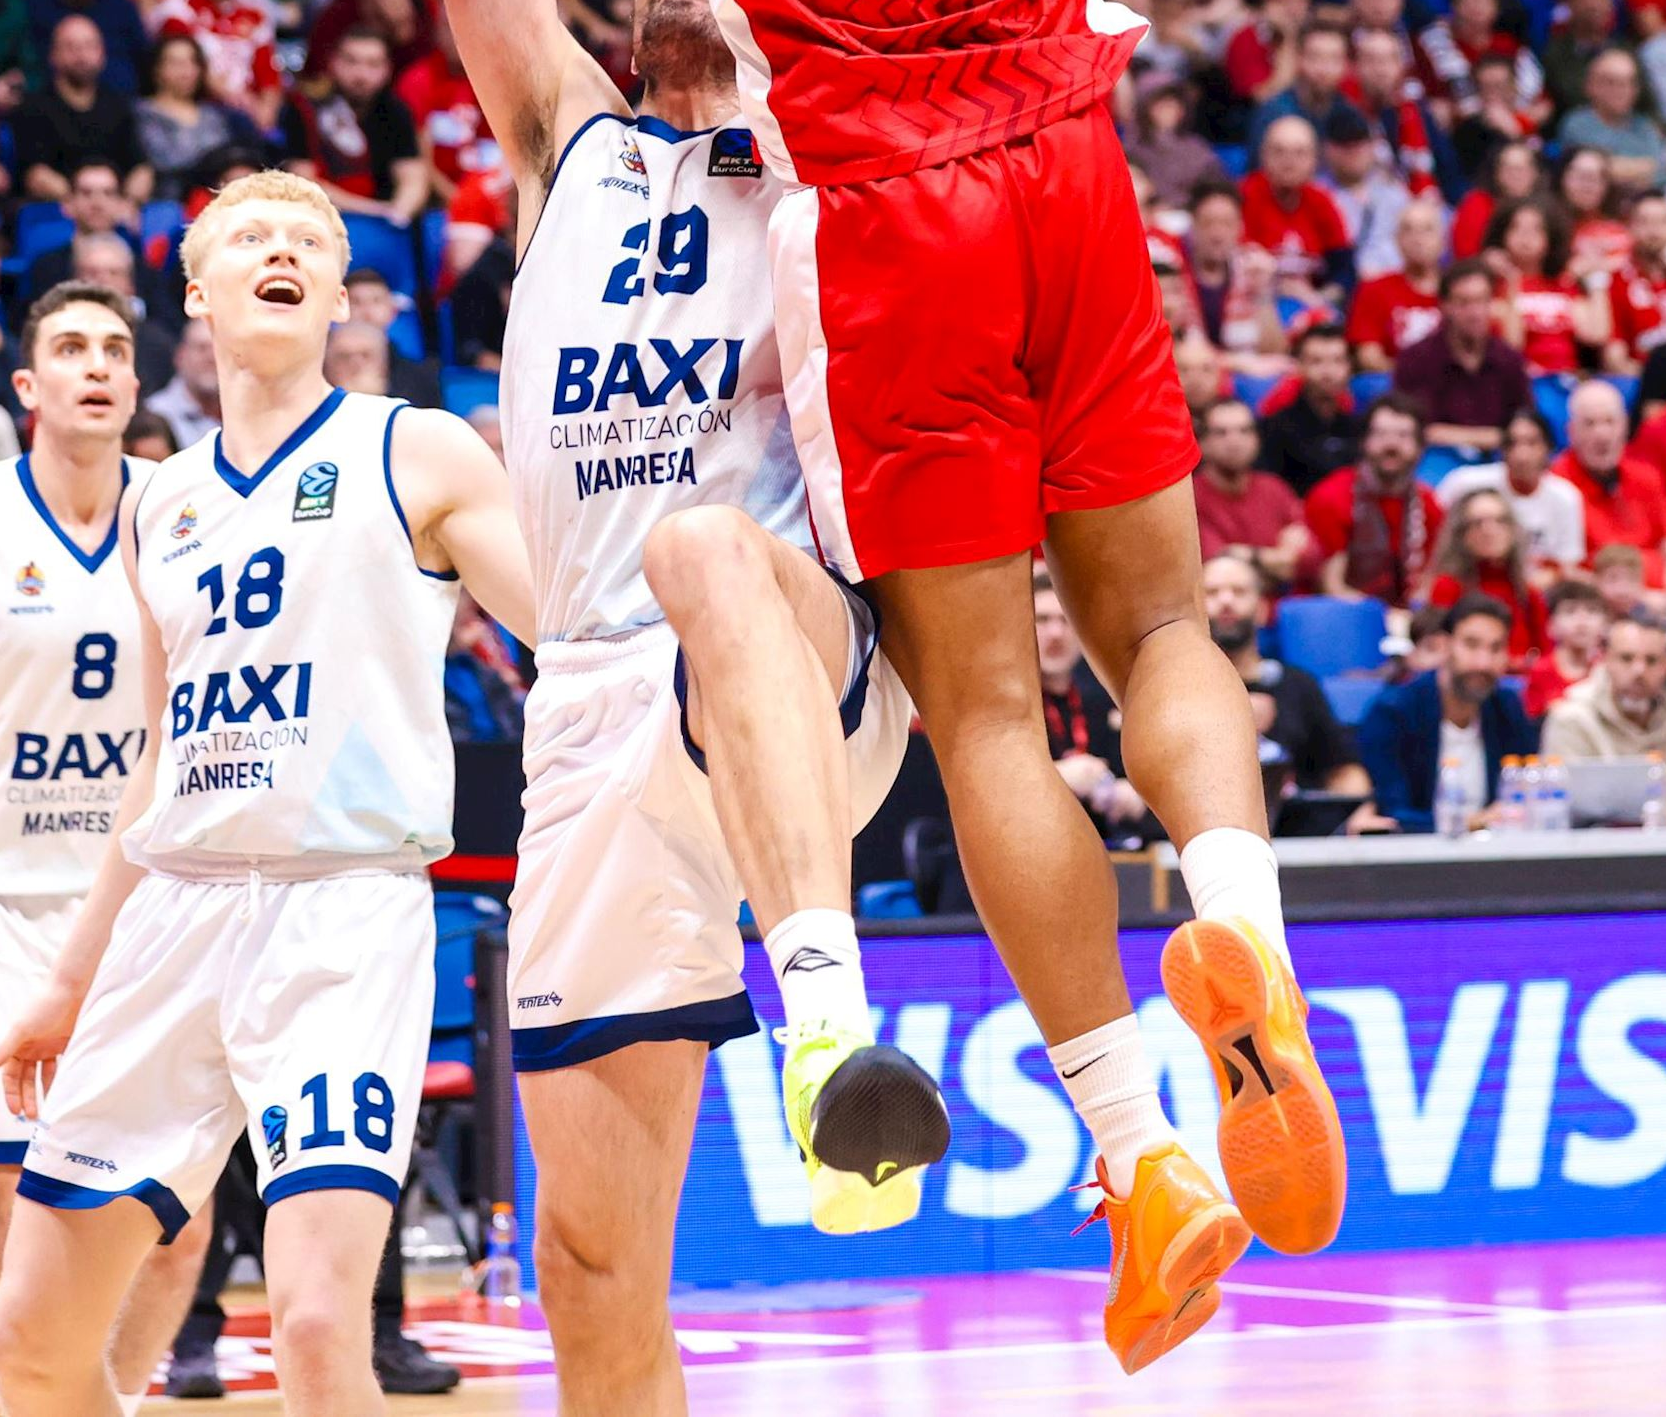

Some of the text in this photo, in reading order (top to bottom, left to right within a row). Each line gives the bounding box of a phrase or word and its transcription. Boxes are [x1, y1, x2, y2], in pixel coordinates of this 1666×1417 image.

[711, 164, 758, 174] EuroCup
[601, 204, 709, 305] 29
[552, 338, 746, 416] BAXI
[550, 404, 731, 449] CLIMATIZACIÓN
[197, 546, 285, 637] 18
[72, 632, 117, 700] 8
[172, 661, 313, 741] BAXI
[22, 810, 118, 835] MANRES
[300, 1072, 395, 1154] 18
